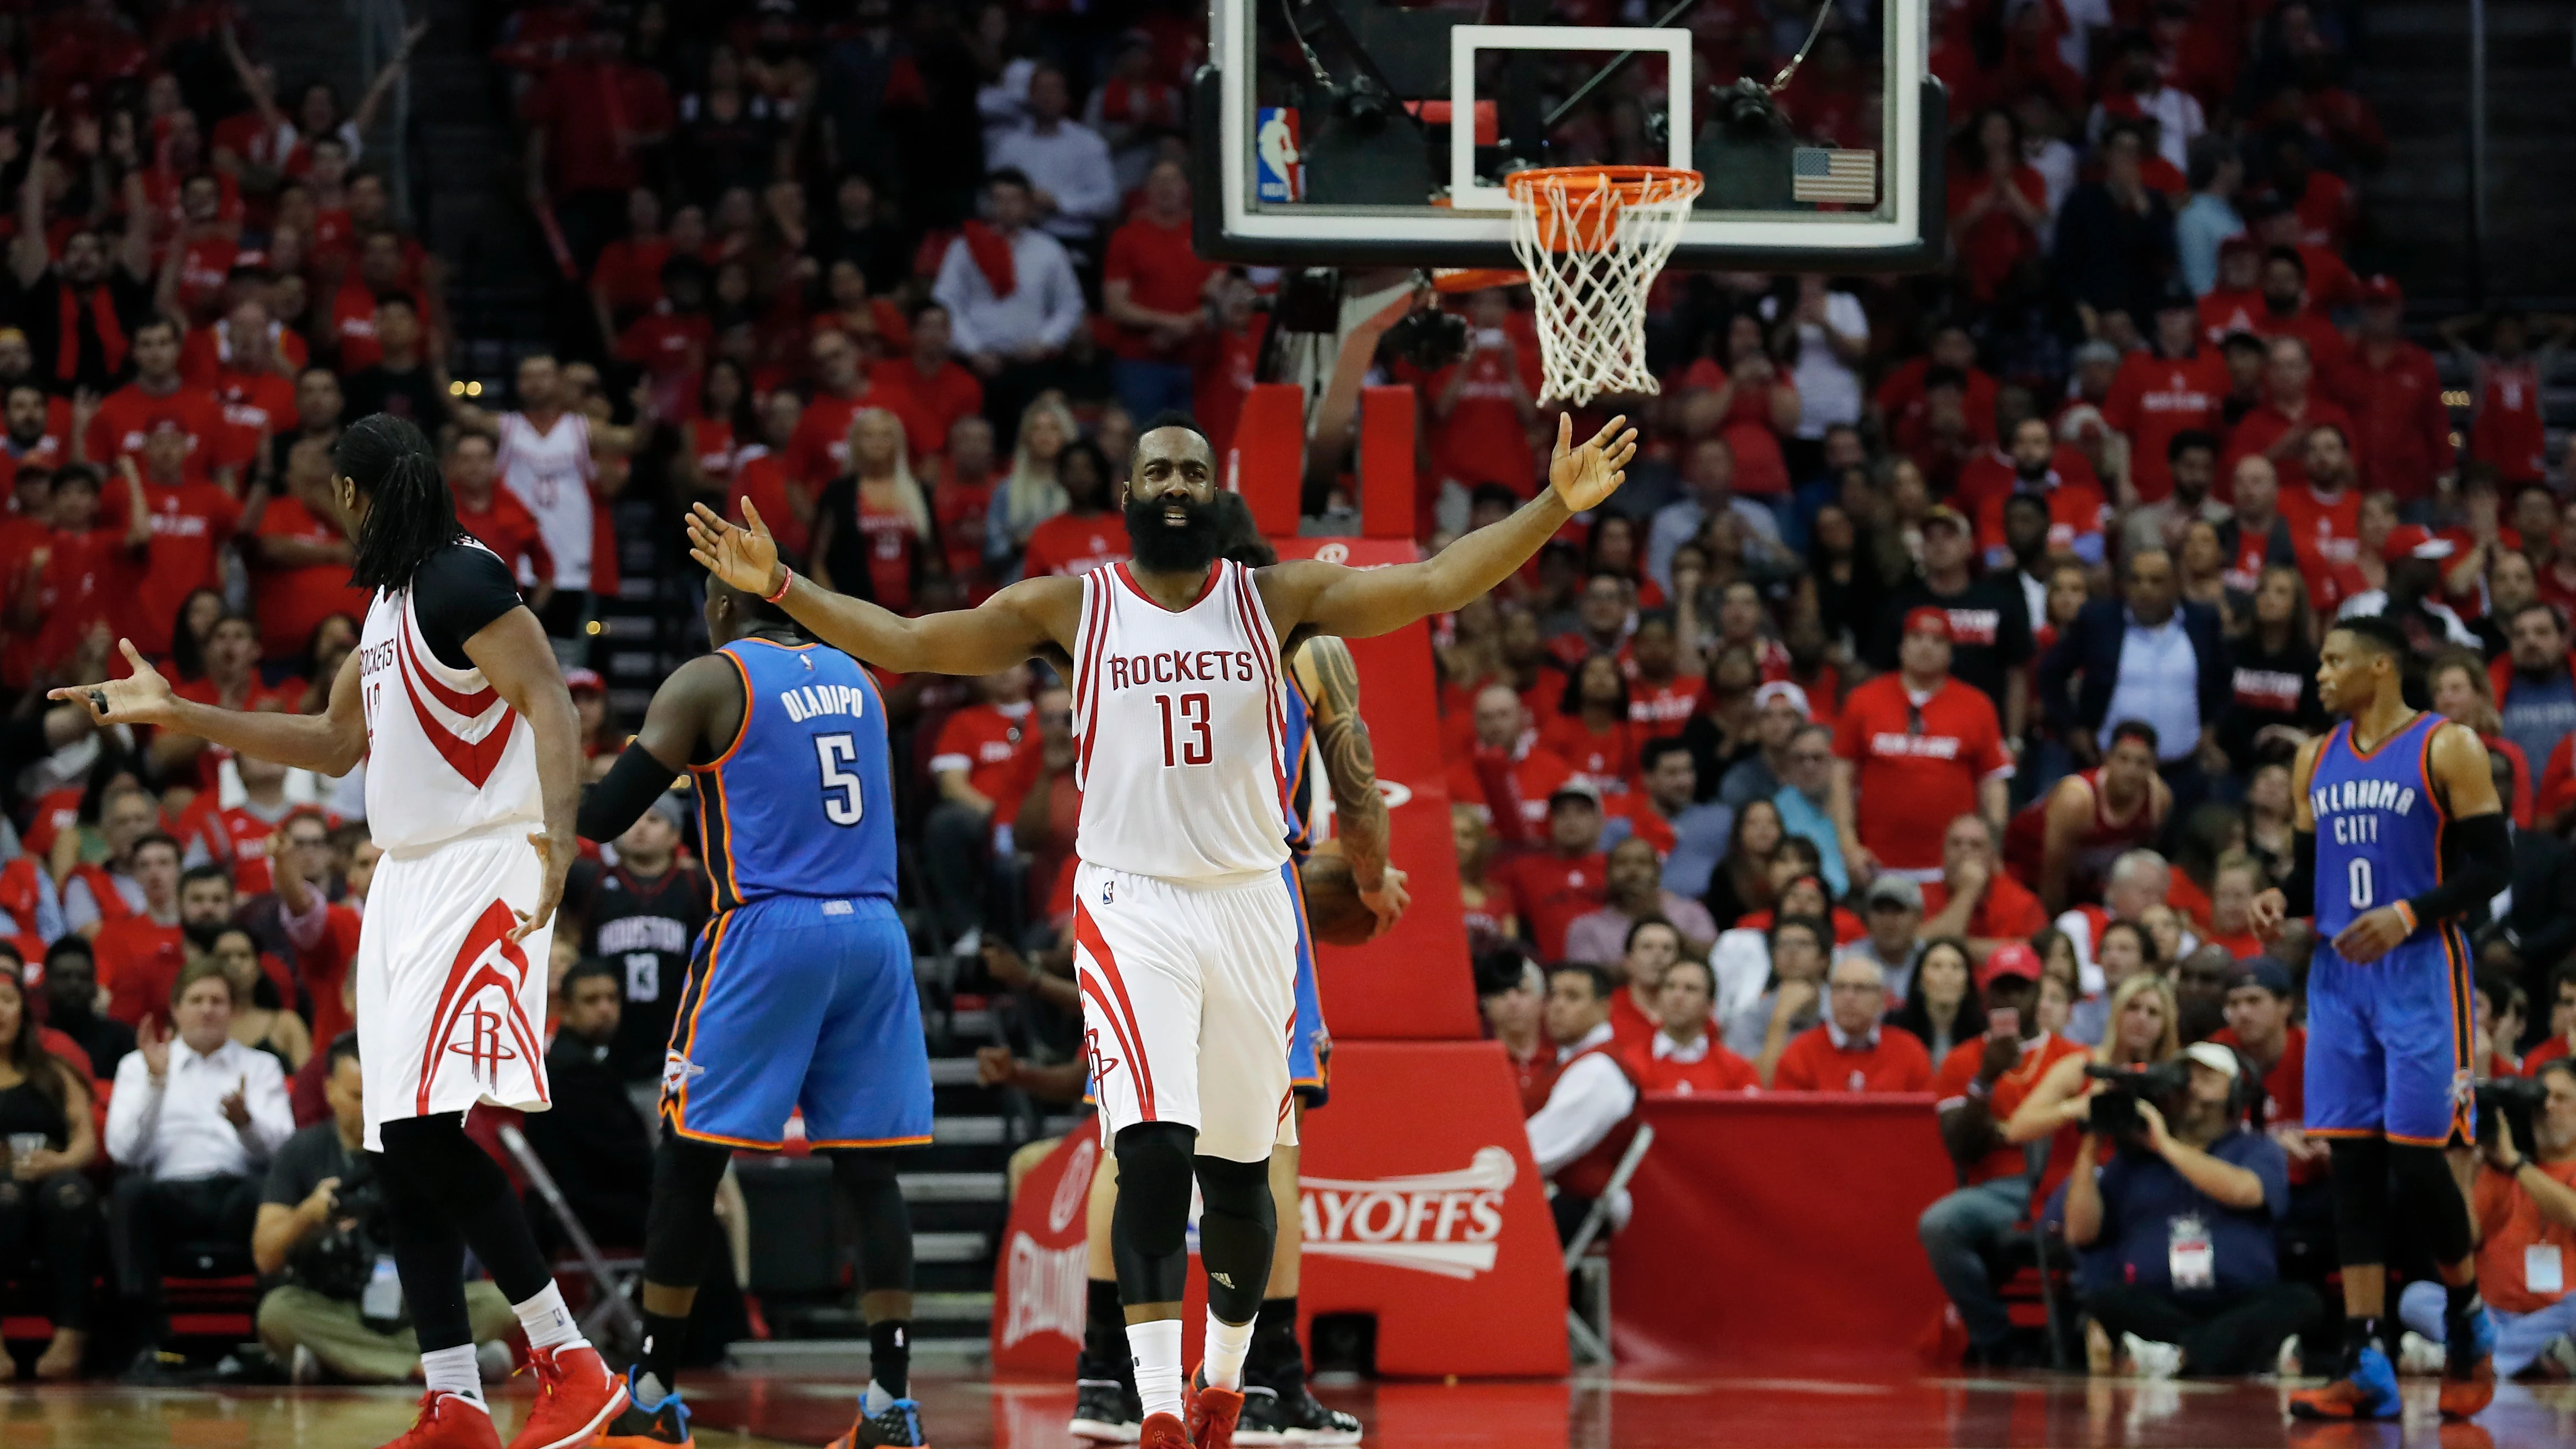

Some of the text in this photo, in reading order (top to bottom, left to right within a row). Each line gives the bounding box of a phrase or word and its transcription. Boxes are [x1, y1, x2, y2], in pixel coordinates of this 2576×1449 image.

[1107, 649, 1253, 691] ROCKETS
[780, 684, 863, 723] OLADIPO
[1154, 692, 1213, 769] 13
[812, 731, 864, 828] 5
[2333, 813, 2378, 846] CITY
[2348, 857, 2373, 910] 0
